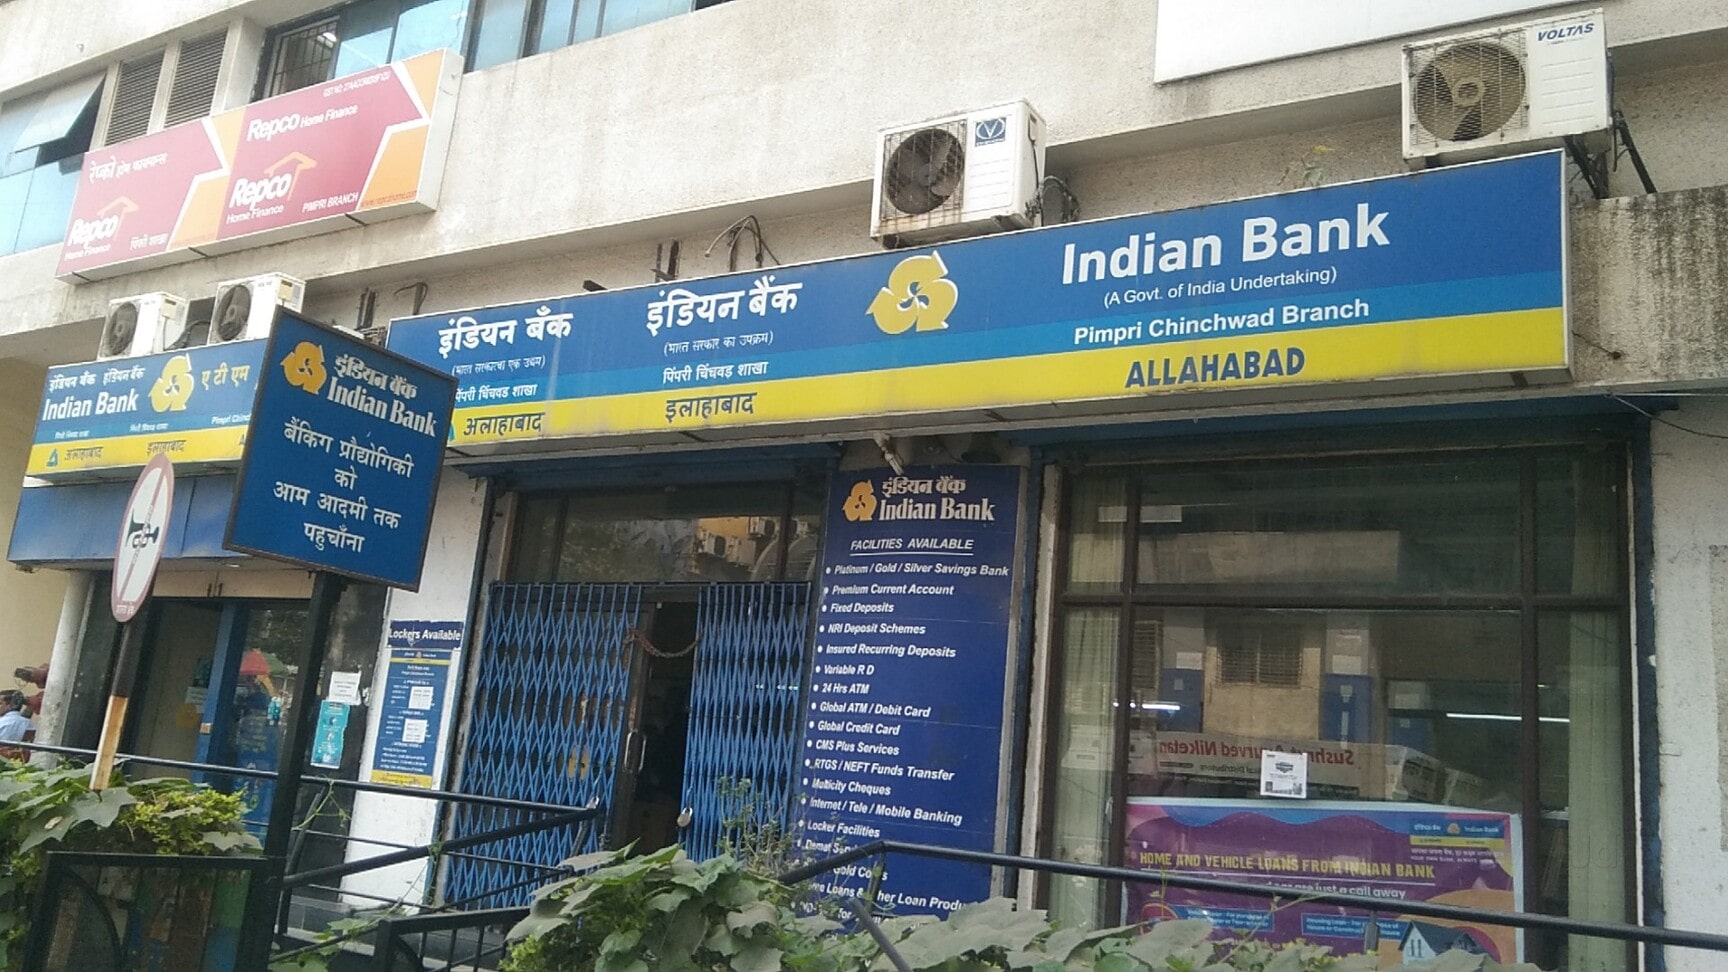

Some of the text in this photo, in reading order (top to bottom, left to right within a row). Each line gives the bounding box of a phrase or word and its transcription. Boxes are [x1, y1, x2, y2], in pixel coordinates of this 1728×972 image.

[1537, 22, 1595, 41] VOLTAS
[247, 105, 358, 142] Repco Home Finance
[229, 173, 292, 210] Repco
[302, 191, 359, 213] PIMPRI BRANCH
[226, 204, 284, 224] Home Finance
[67, 214, 119, 249] Repco
[1062, 203, 1390, 285] Indian Bank
[1104, 266, 1337, 309] (A Govt. of India Undertaking)
[646, 275, 803, 337] इंडियन बैंक
[438, 305, 574, 359] इंडियन बँक
[1074, 299, 1370, 345] Pimpri Chinchwad Branch
[692, 338, 720, 352] सरकार
[723, 336, 736, 348] का
[739, 330, 774, 346] उपक्रम)
[201, 361, 251, 391] ए टी एम
[334, 354, 418, 400] इंडियन बैंक
[663, 361, 769, 384] पिंपरी चिंचवड शाखा
[1125, 347, 1305, 389] ALLAHABAD
[49, 374, 78, 394] इंडियन
[478, 384, 511, 401] चिंचवड
[512, 384, 538, 397] शाखा
[42, 388, 140, 421] Indian Bank
[327, 376, 437, 438] Indian Bank
[665, 392, 758, 423] इलाहाबाद
[463, 412, 546, 436] अलाहाबाद
[339, 436, 415, 478] प्रौद्योगिकी
[334, 465, 358, 490] को
[882, 475, 967, 498] इंडियन बैंक
[273, 481, 402, 529] आम आदमी तक
[879, 497, 997, 521] Indian Bank
[850, 538, 974, 551] FACILITIES AVAILABLE
[834, 563, 1010, 577] Platinum Gold Silver Savings Bank
[832, 584, 955, 596] Premium Current Account
[830, 602, 894, 615] Fixed Deposits
[389, 628, 461, 641] Lockers Available
[828, 623, 926, 635] NRI Deposit Schemes
[826, 643, 957, 659] Insured Recurring Deposits
[824, 664, 875, 675] Variable R D
[821, 683, 870, 694] 24 Hrs ATM
[819, 701, 932, 718] Global ATM Debit Card
[818, 720, 901, 736] Global Credit Card
[815, 739, 900, 756] CMS Plus Services
[814, 758, 956, 781] RTGS NEFT Funds Transfer
[812, 778, 892, 796] Multicity Cheques
[810, 797, 963, 827] Internet Tele Mobile Banking
[807, 819, 880, 838] Locker Facilities
[1140, 852, 1435, 878] HOME AND VEHICLE LOANS FROM INDIAN BANK
[897, 892, 927, 907] Loan
[1315, 882, 1337, 894] just
[1349, 886, 1371, 897] call
[1373, 887, 1406, 899] away
